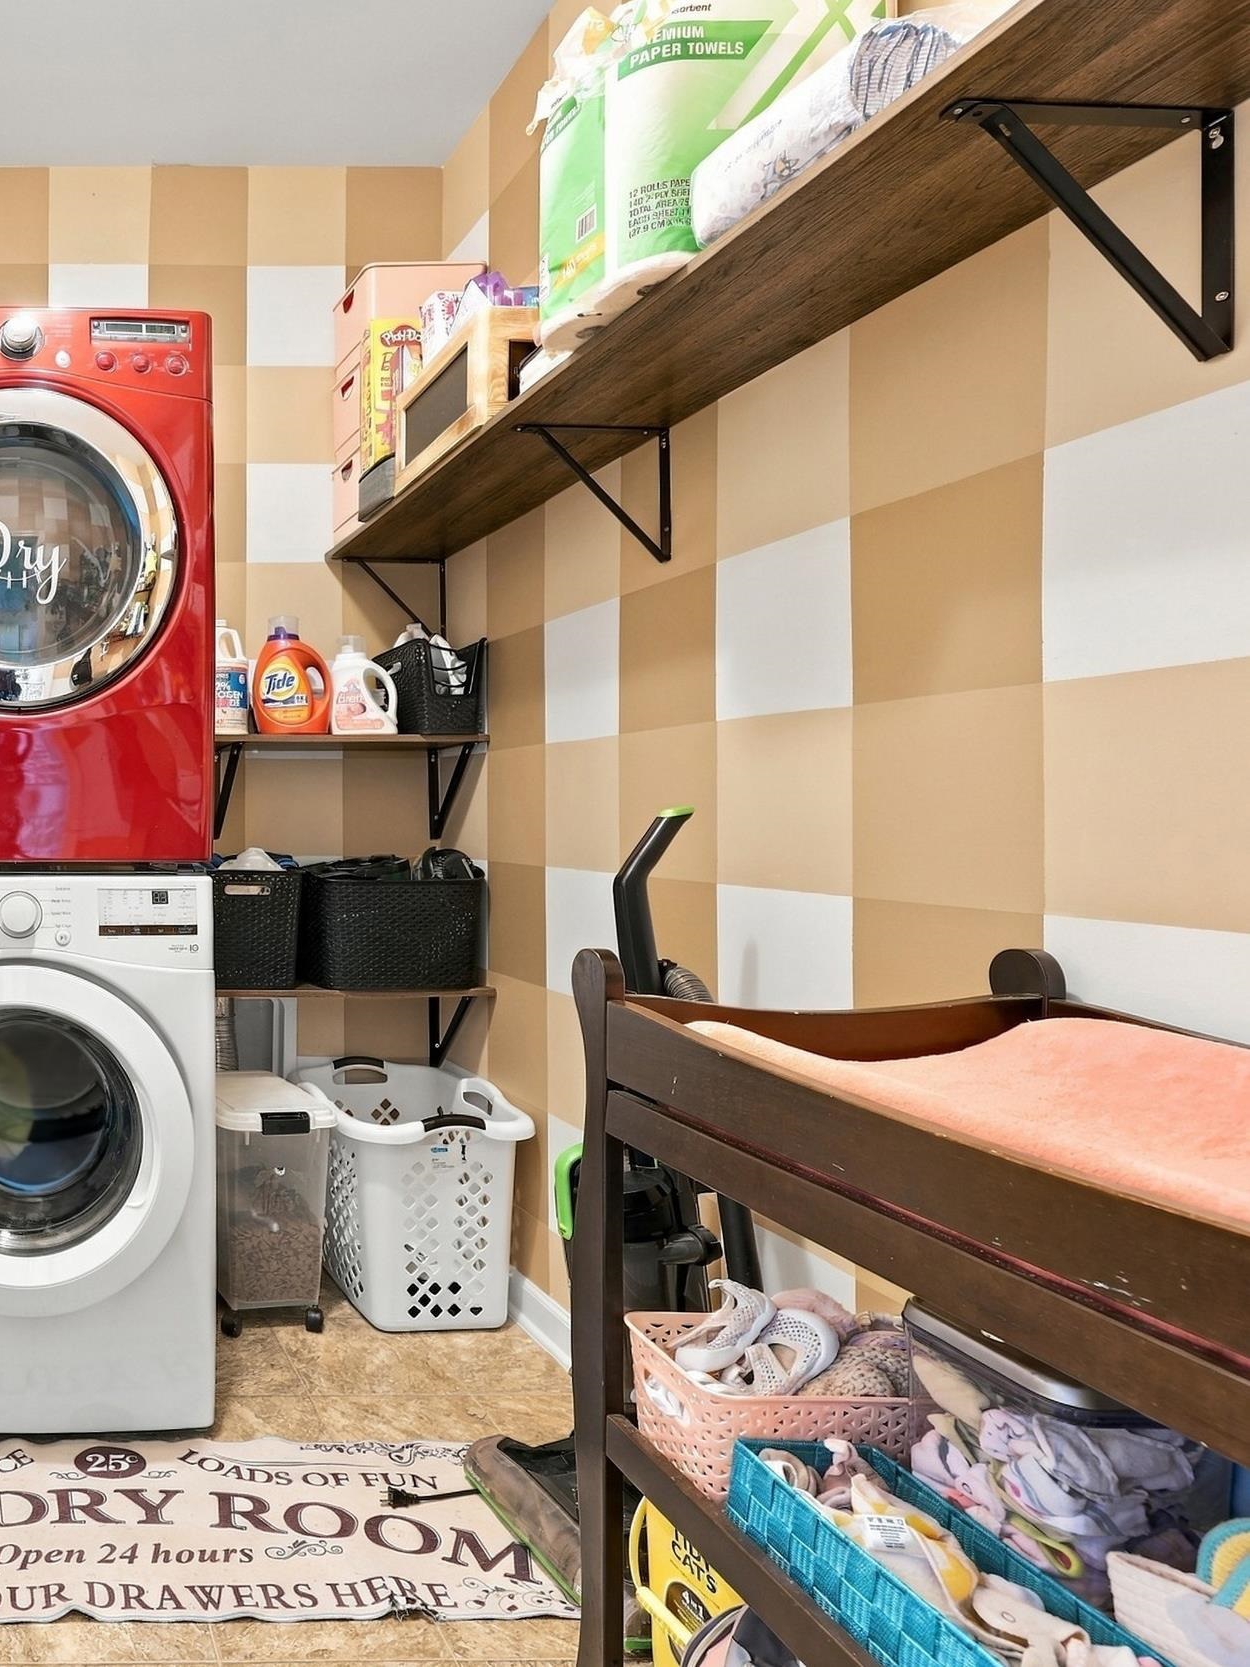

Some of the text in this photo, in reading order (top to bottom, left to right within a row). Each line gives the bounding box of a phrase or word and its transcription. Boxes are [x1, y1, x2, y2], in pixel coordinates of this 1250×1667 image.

[652, 26, 705, 43] EMIUM
[630, 41, 744, 69] PAPER TOWELS
[640, 180, 669, 195] ROLLS
[670, 178, 691, 188] PAPE
[380, 327, 423, 347] Play-Do
[264, 675, 296, 695] Tide
[177, 1448, 438, 1490] LOADS OF FUN
[208, 1490, 543, 1586] ROOM
[96, 1543, 139, 1565] 24
[151, 1543, 254, 1565] hours
[671, 1540, 717, 1594] CATS
[83, 1580, 319, 1612] DRAWERS
[325, 1575, 459, 1609] HERE
